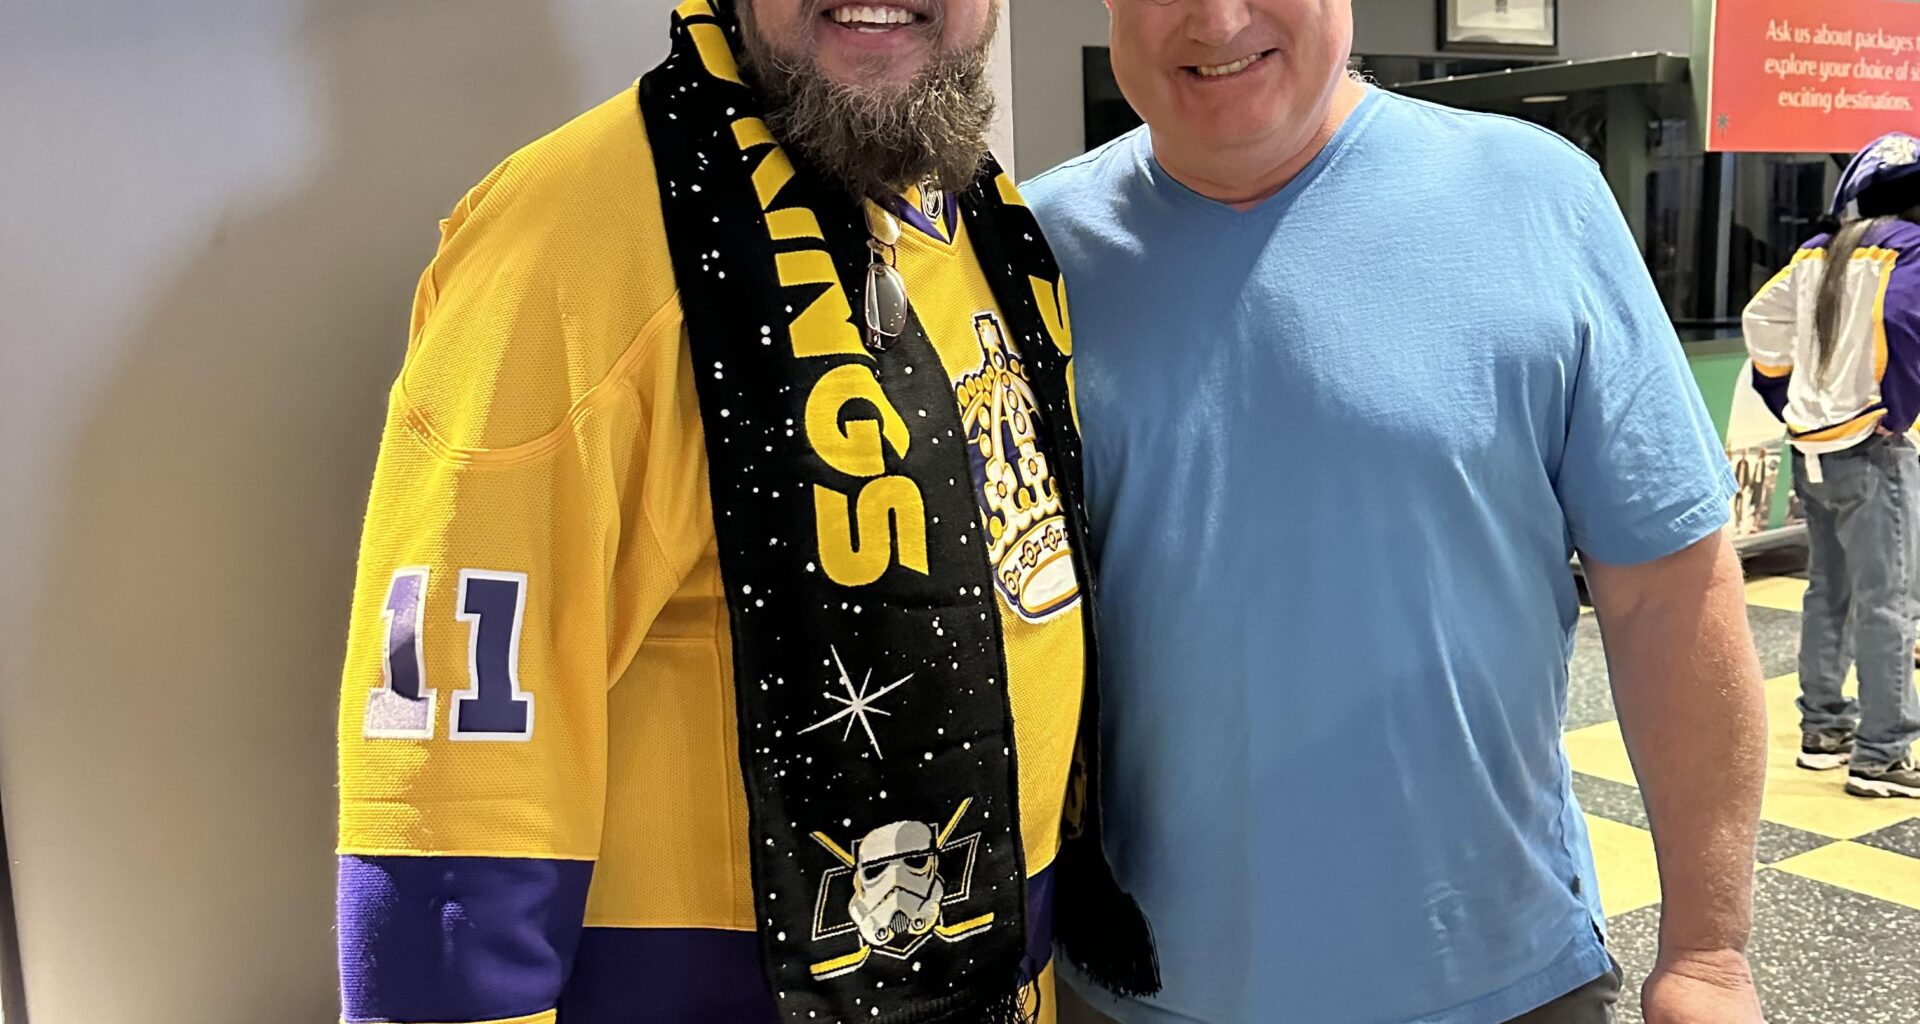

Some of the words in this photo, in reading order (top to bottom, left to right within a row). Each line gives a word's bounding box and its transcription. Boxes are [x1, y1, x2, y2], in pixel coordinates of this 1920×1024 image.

[1766, 19, 1791, 42] Ask
[1794, 28, 1811, 44] us
[1813, 24, 1852, 47] about
[1855, 28, 1914, 55] packages
[1764, 53, 1817, 79] explore
[1819, 58, 1852, 81] your
[1853, 57, 1893, 80] choice
[1895, 60, 1909, 81] of
[1778, 86, 1832, 114] exciting
[1834, 87, 1913, 111] destinations.
[364, 565, 535, 742] 11
